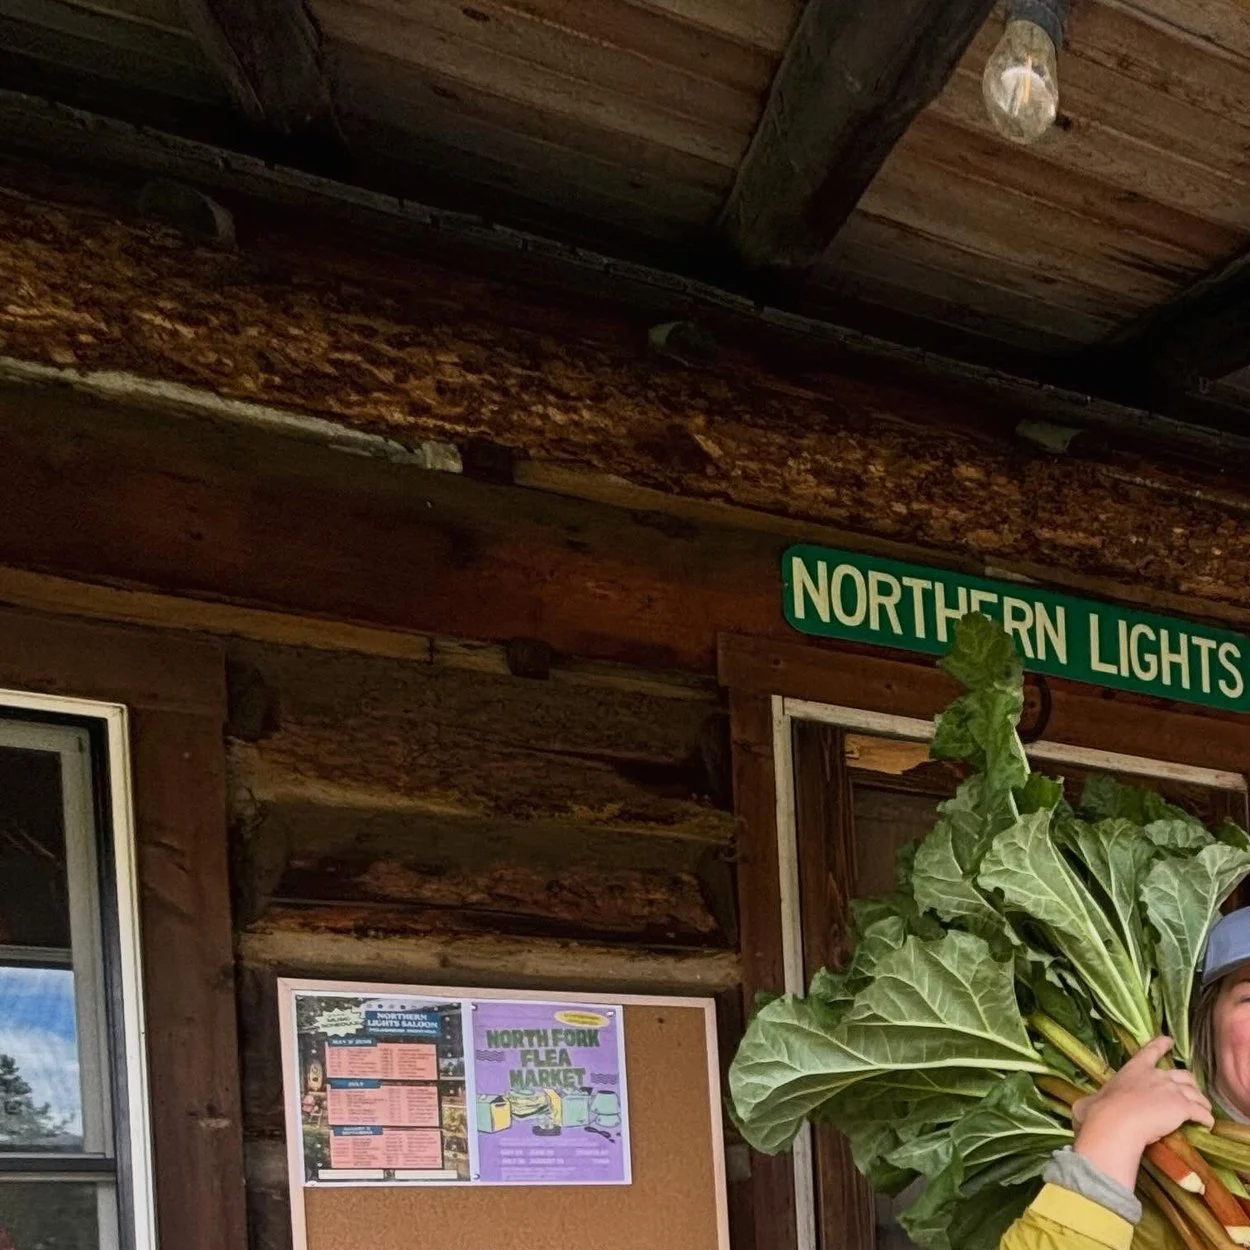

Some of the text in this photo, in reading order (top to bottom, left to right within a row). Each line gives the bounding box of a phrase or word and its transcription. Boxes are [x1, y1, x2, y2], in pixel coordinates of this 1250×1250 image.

[1089, 612, 1245, 699] LIGHTS
[367, 1019, 438, 1029] LIGHTS SALOON
[377, 1012, 428, 1021] NORTHERN
[486, 1028, 600, 1048] NORTH FORK
[520, 1048, 572, 1067] FLEA
[509, 1068, 586, 1090] MARKET
